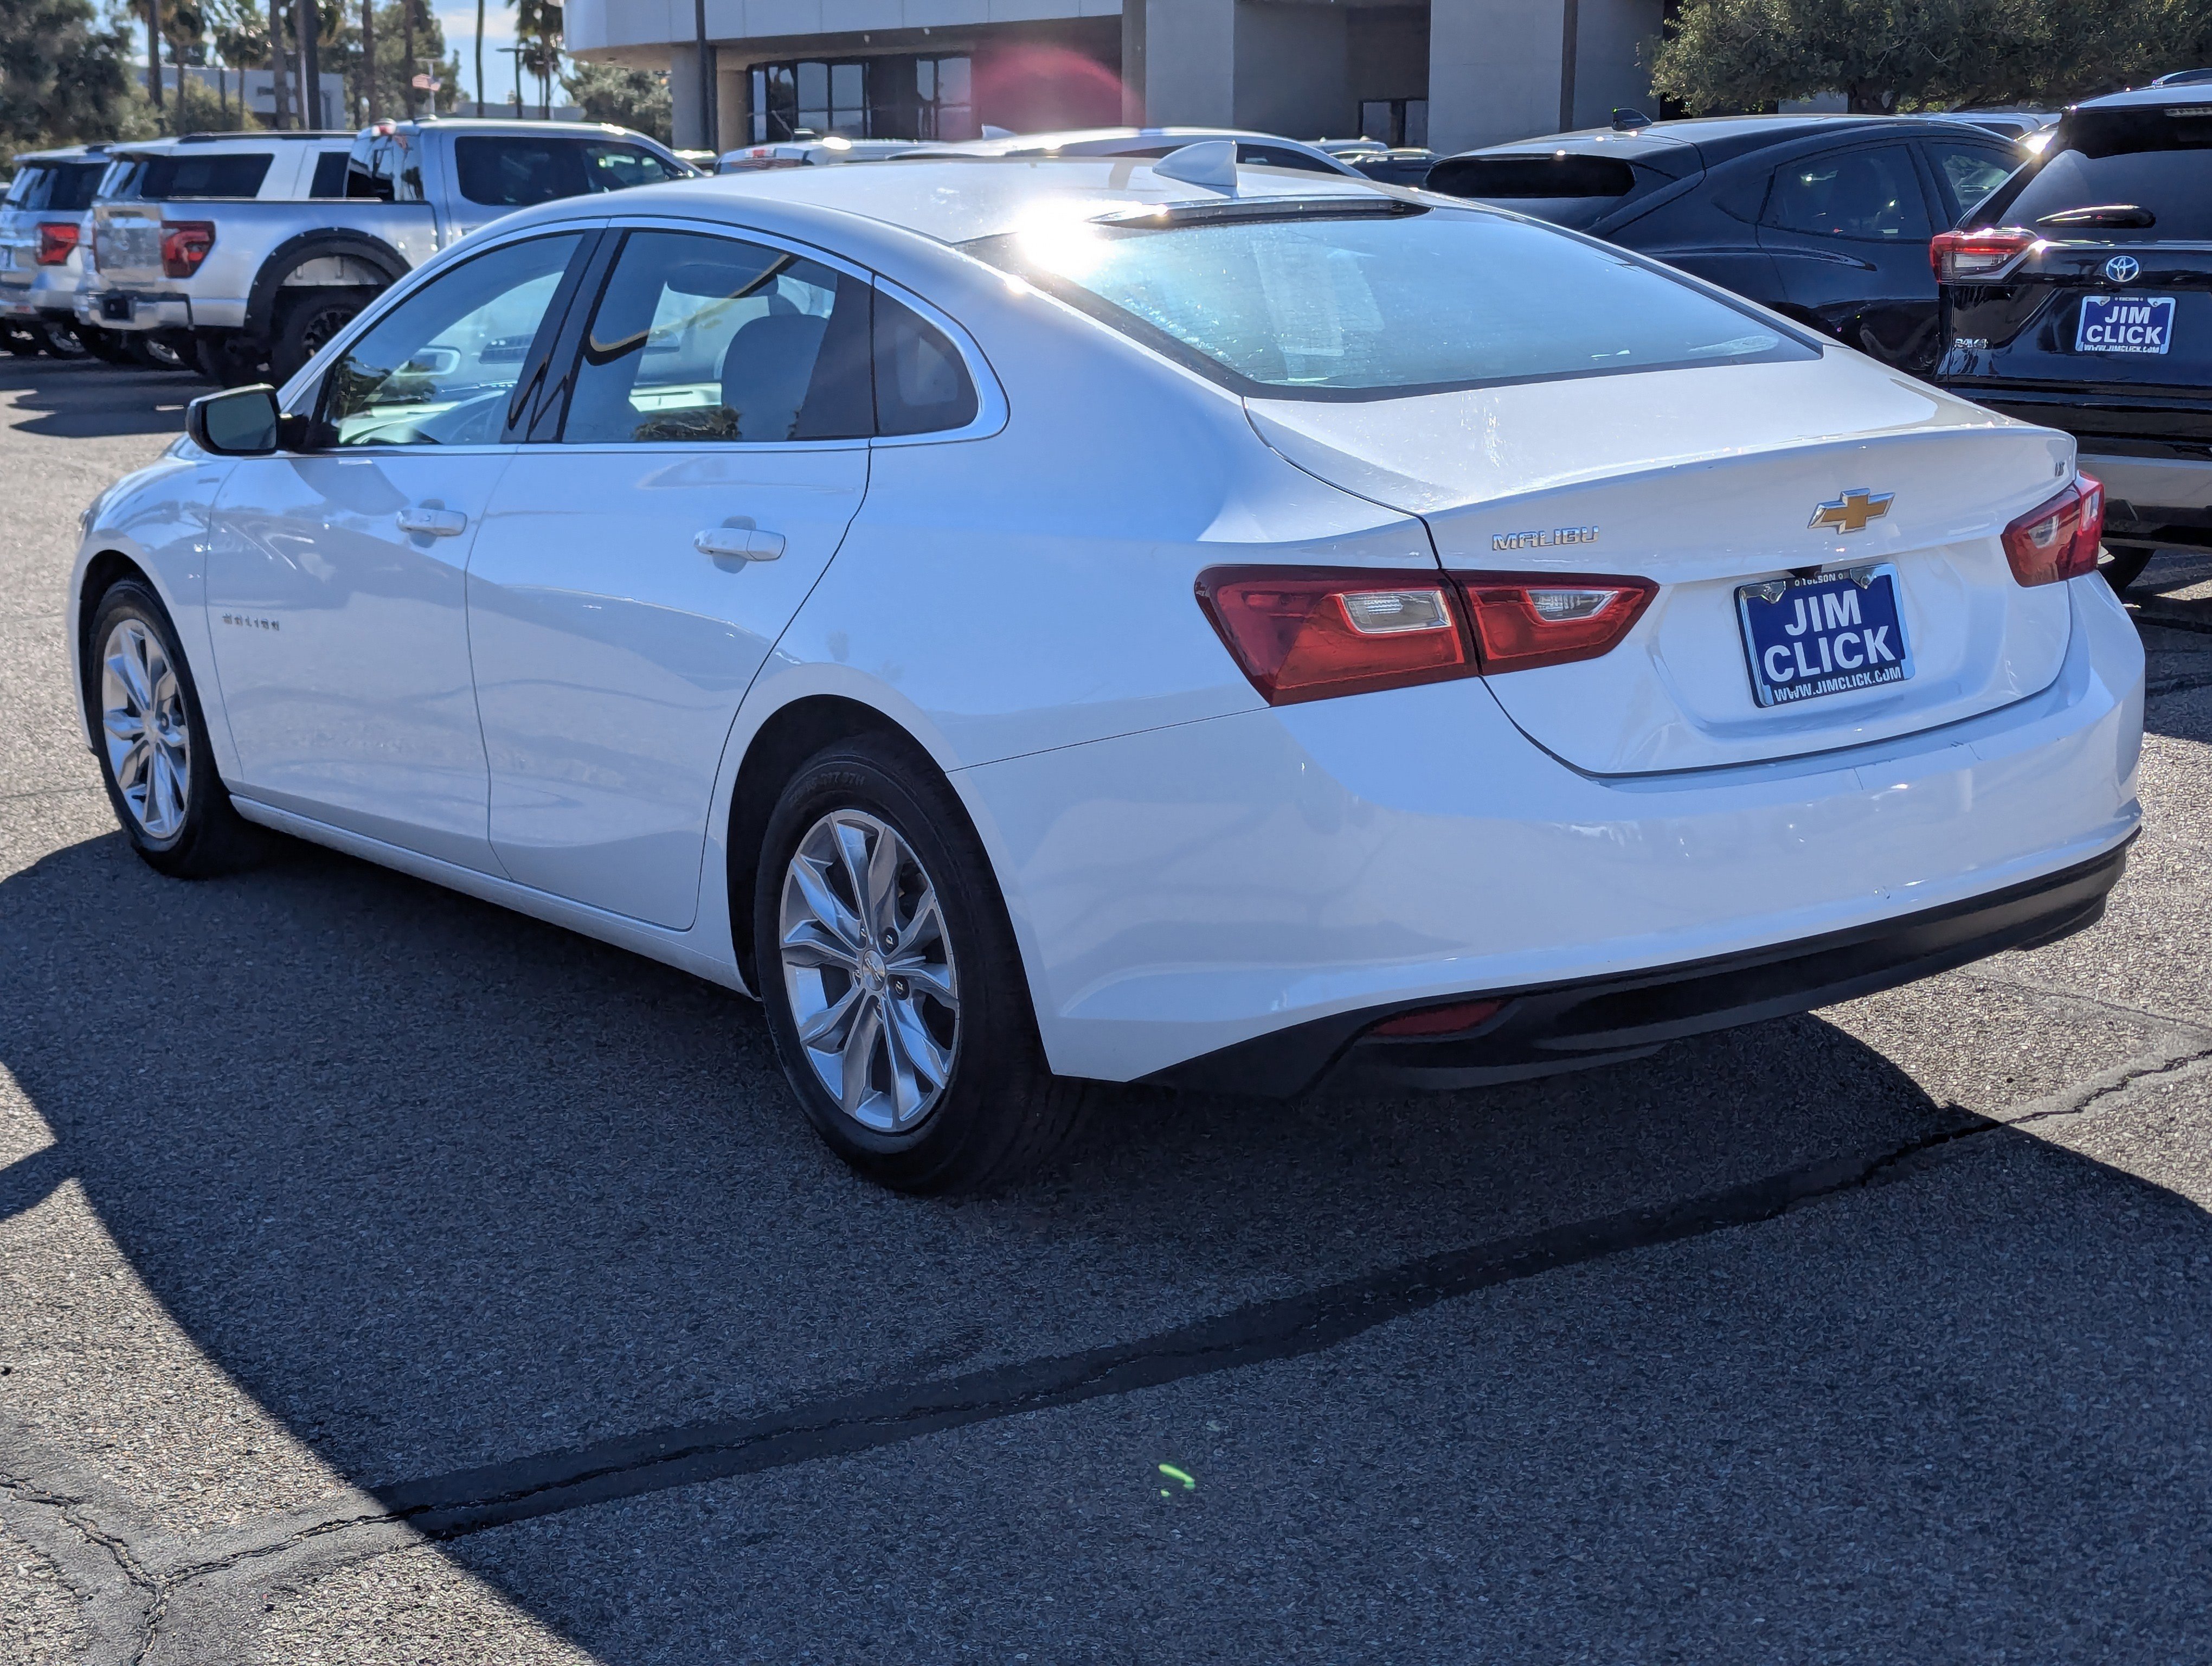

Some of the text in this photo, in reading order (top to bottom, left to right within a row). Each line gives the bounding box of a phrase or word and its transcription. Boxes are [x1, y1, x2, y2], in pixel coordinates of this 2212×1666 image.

[2105, 306, 2151, 324] JIM
[2086, 325, 2163, 344] CLICK
[1492, 526, 1599, 550] MALIBU
[1785, 589, 1862, 636] JIM
[1764, 625, 1896, 683] CLICK
[1773, 667, 1901, 702] WWW.JIMCLICK.COM
